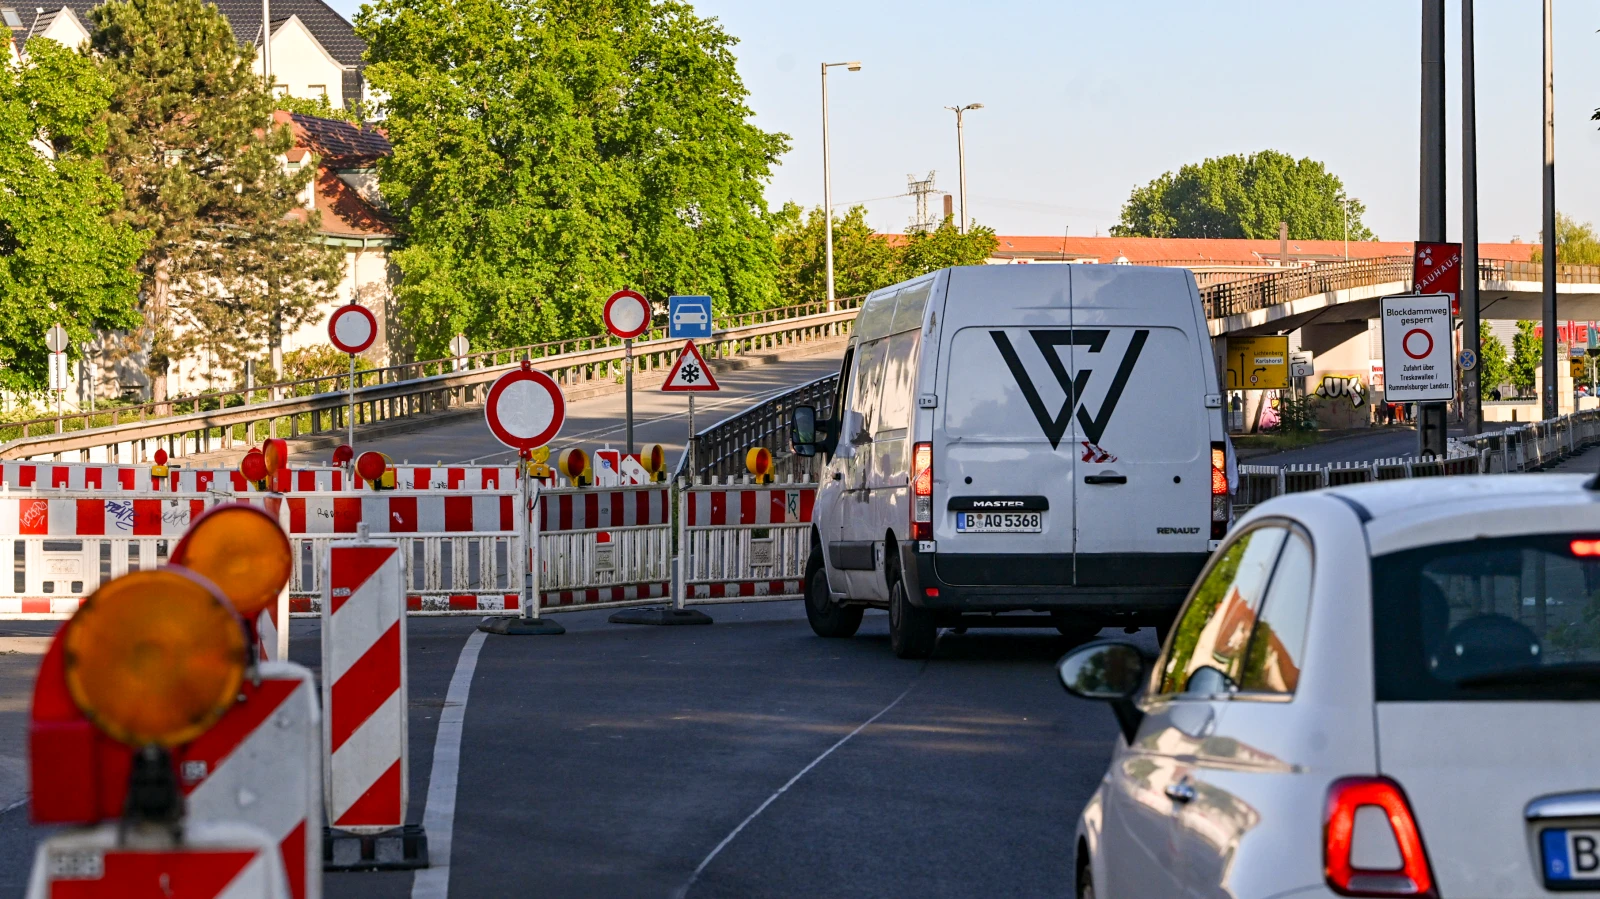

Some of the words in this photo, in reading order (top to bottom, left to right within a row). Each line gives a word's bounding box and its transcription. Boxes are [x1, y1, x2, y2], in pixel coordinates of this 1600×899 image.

[1415, 254, 1459, 290] BAUHAUS
[1386, 308, 1447, 316] Blockdammweg
[1401, 316, 1434, 326] gesperrt
[1403, 364, 1422, 372] Zufahrt
[966, 514, 975, 528] B
[984, 514, 1003, 528] AQ
[1005, 514, 1039, 528] 5368
[1572, 836, 1600, 872] B
